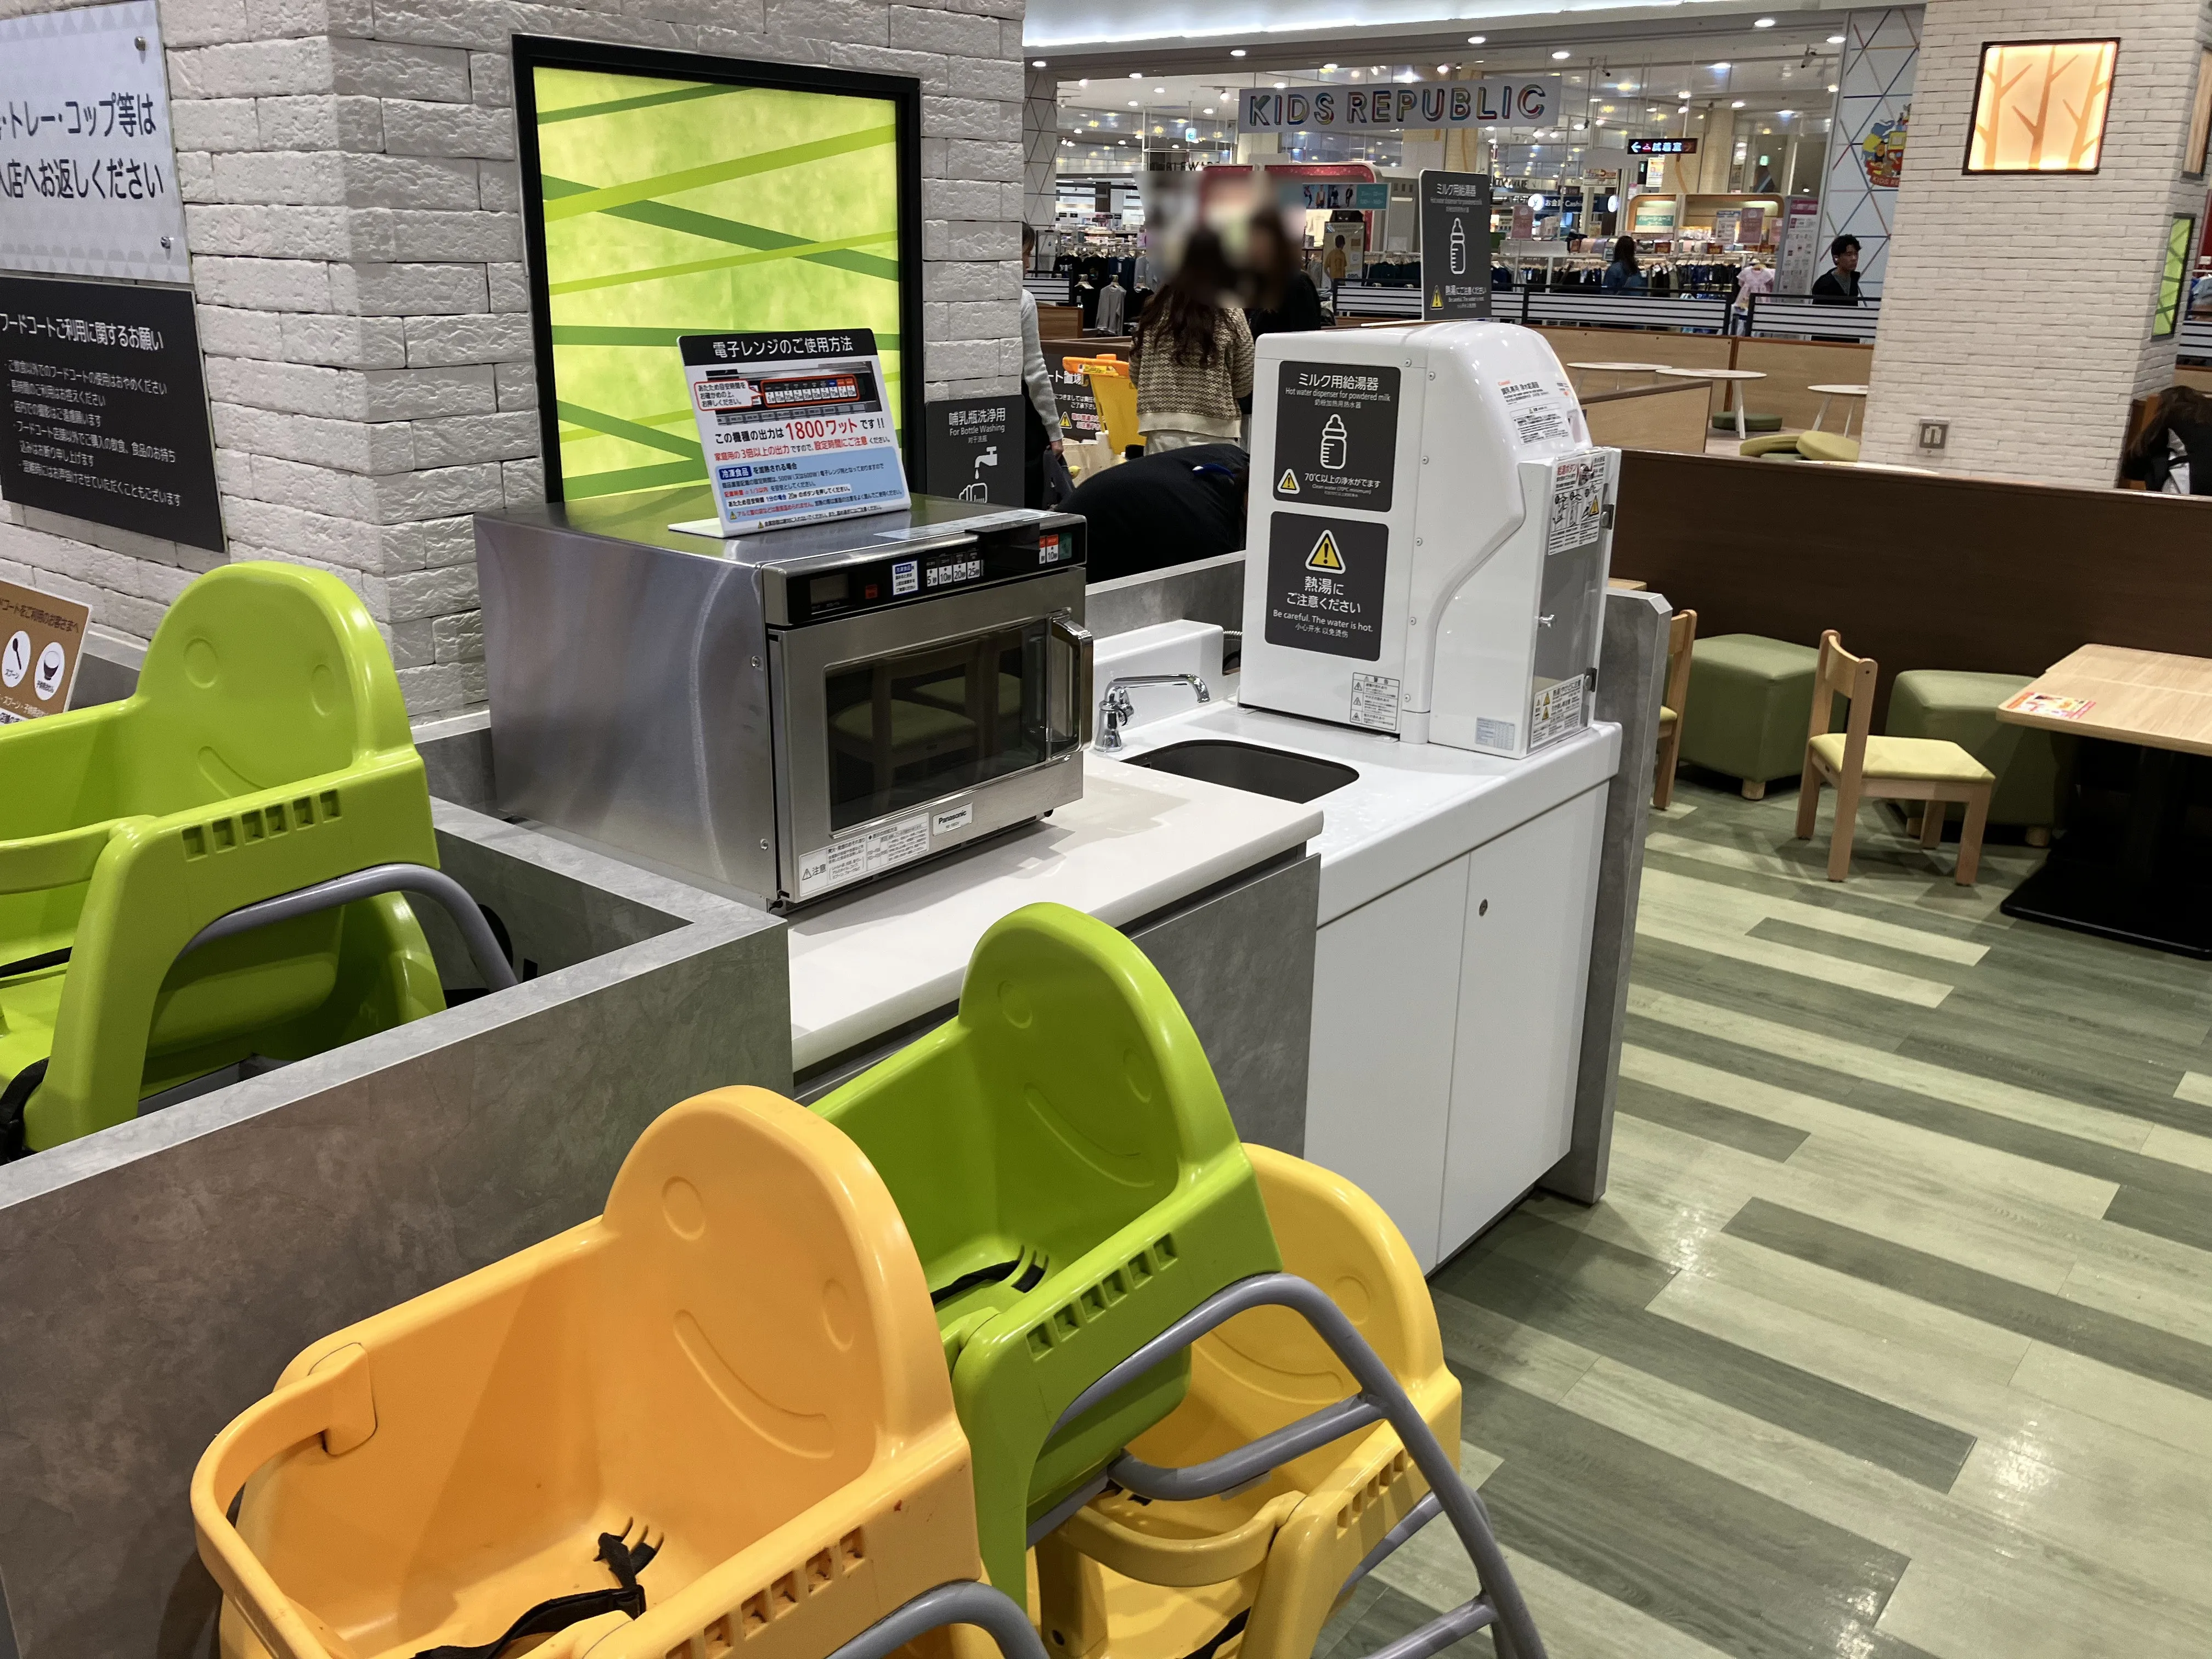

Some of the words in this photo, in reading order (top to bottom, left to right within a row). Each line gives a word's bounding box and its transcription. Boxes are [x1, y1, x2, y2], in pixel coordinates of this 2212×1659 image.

[1250, 92, 1334, 126] KIDS
[1347, 84, 1545, 123] REPUBLIC
[0, 92, 156, 139] ・トレー・コップ等は
[713, 336, 854, 358] 電子レンジのご使用方法
[1298, 373, 1379, 391] ミルク用給湯器
[1313, 389, 1339, 398] dispenser
[1339, 390, 1348, 398] for
[1348, 392, 1378, 401] powdered
[949, 408, 1005, 426] 哺乳瓶洗浄用
[949, 428, 960, 436] For
[961, 426, 979, 435] Bottle
[979, 424, 1005, 433] Washing
[1304, 576, 1344, 595] 熱湯に
[1286, 592, 1361, 613] ご注意ください
[1273, 610, 1283, 618] Be
[1283, 611, 1311, 622] careful.
[1312, 616, 1325, 625] The
[1327, 619, 1350, 628] water
[938, 810, 967, 825] Panasonic
[812, 864, 826, 876] 注意
